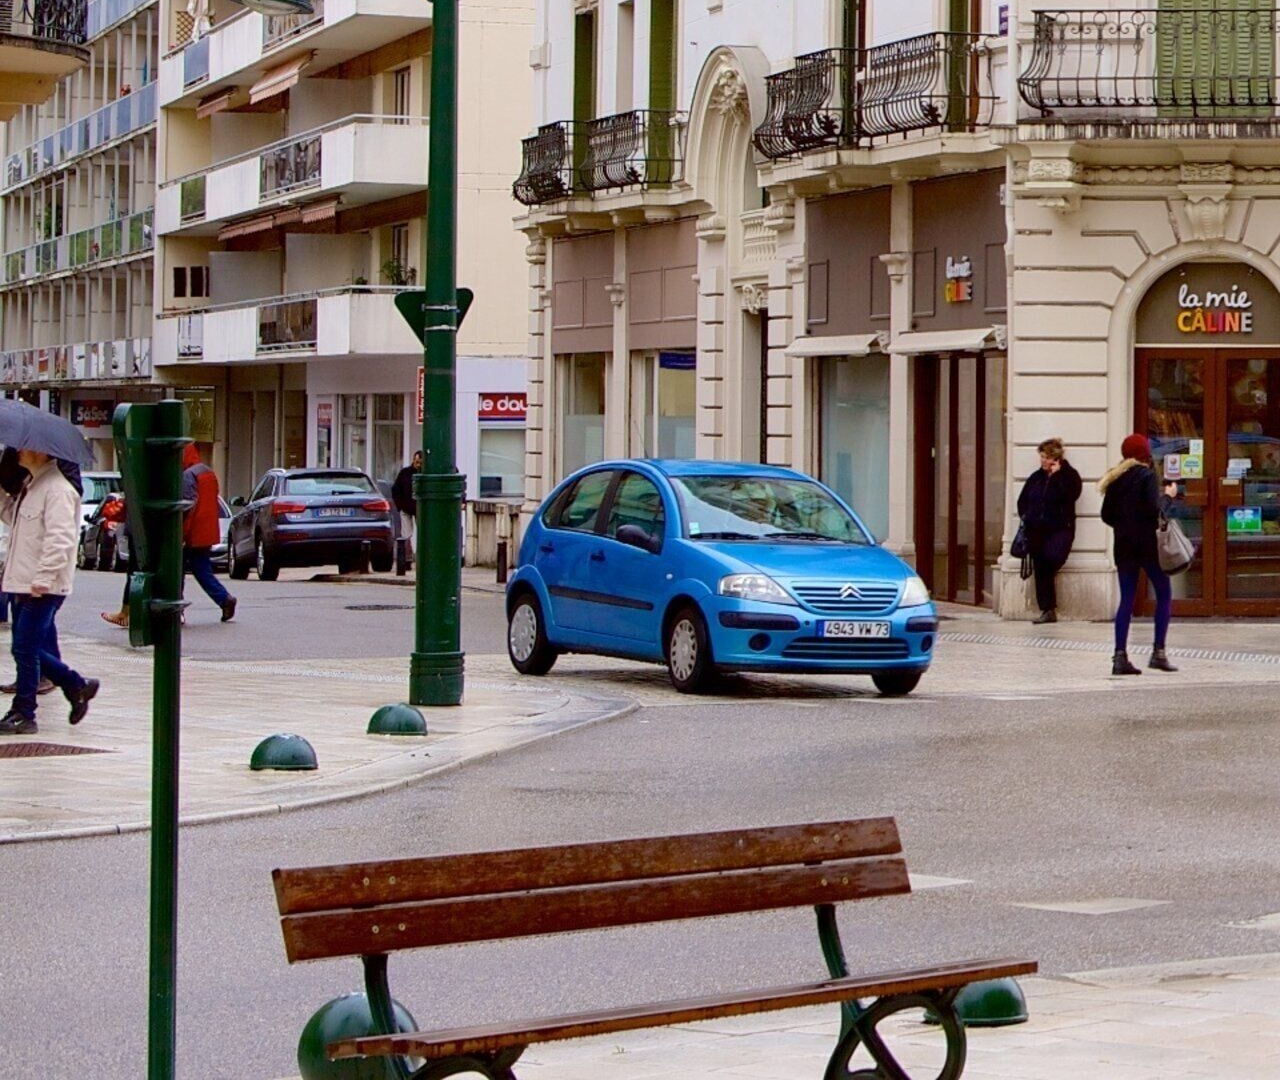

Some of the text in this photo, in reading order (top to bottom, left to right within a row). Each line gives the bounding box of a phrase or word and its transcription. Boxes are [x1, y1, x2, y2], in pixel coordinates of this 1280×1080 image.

[1178, 283, 1252, 308] la mie
[1177, 307, 1253, 333] CÂLINE
[826, 622, 889, 636] 4943 VW 73
